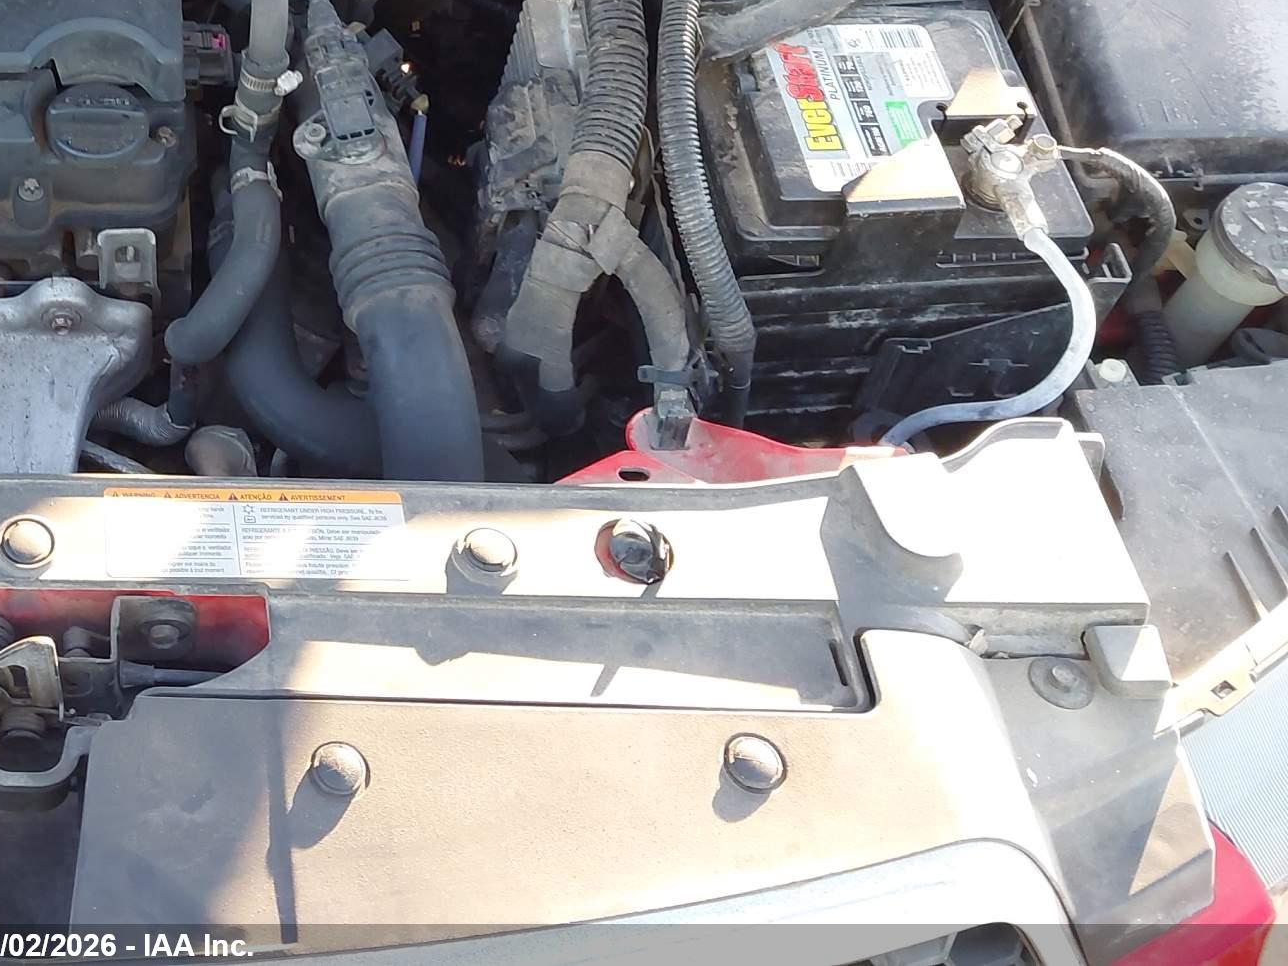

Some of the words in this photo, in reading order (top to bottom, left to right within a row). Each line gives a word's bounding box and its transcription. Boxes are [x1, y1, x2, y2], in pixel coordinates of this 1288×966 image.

[773, 40, 845, 152] EverStart
[815, 50, 840, 101] PLATINUM
[240, 492, 272, 501] ATENÇÃO
